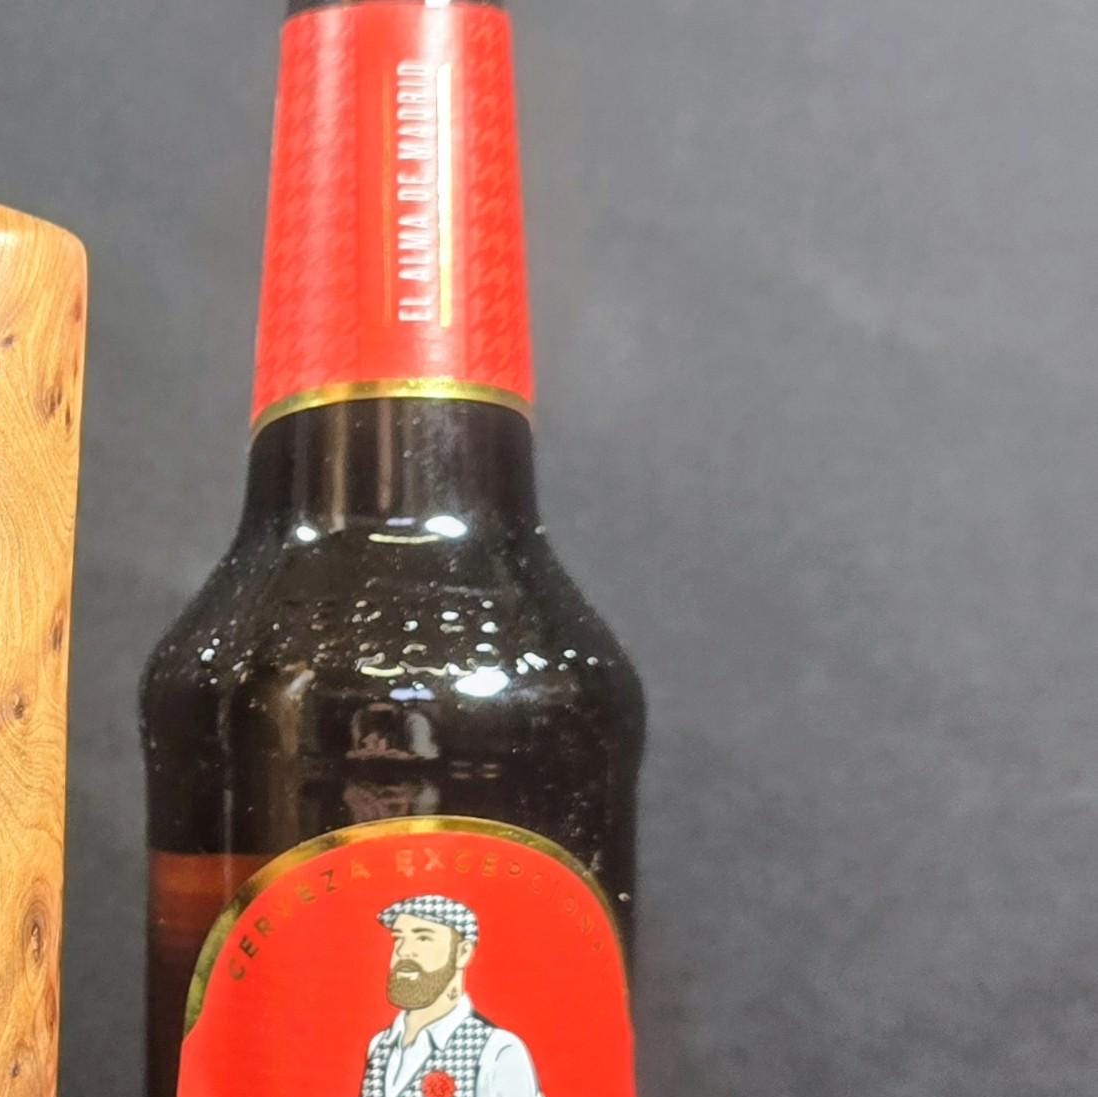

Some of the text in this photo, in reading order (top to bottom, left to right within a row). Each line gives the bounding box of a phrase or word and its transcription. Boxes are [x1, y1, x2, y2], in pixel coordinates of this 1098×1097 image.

[396, 60, 434, 322] EL ALMA DE MADRID
